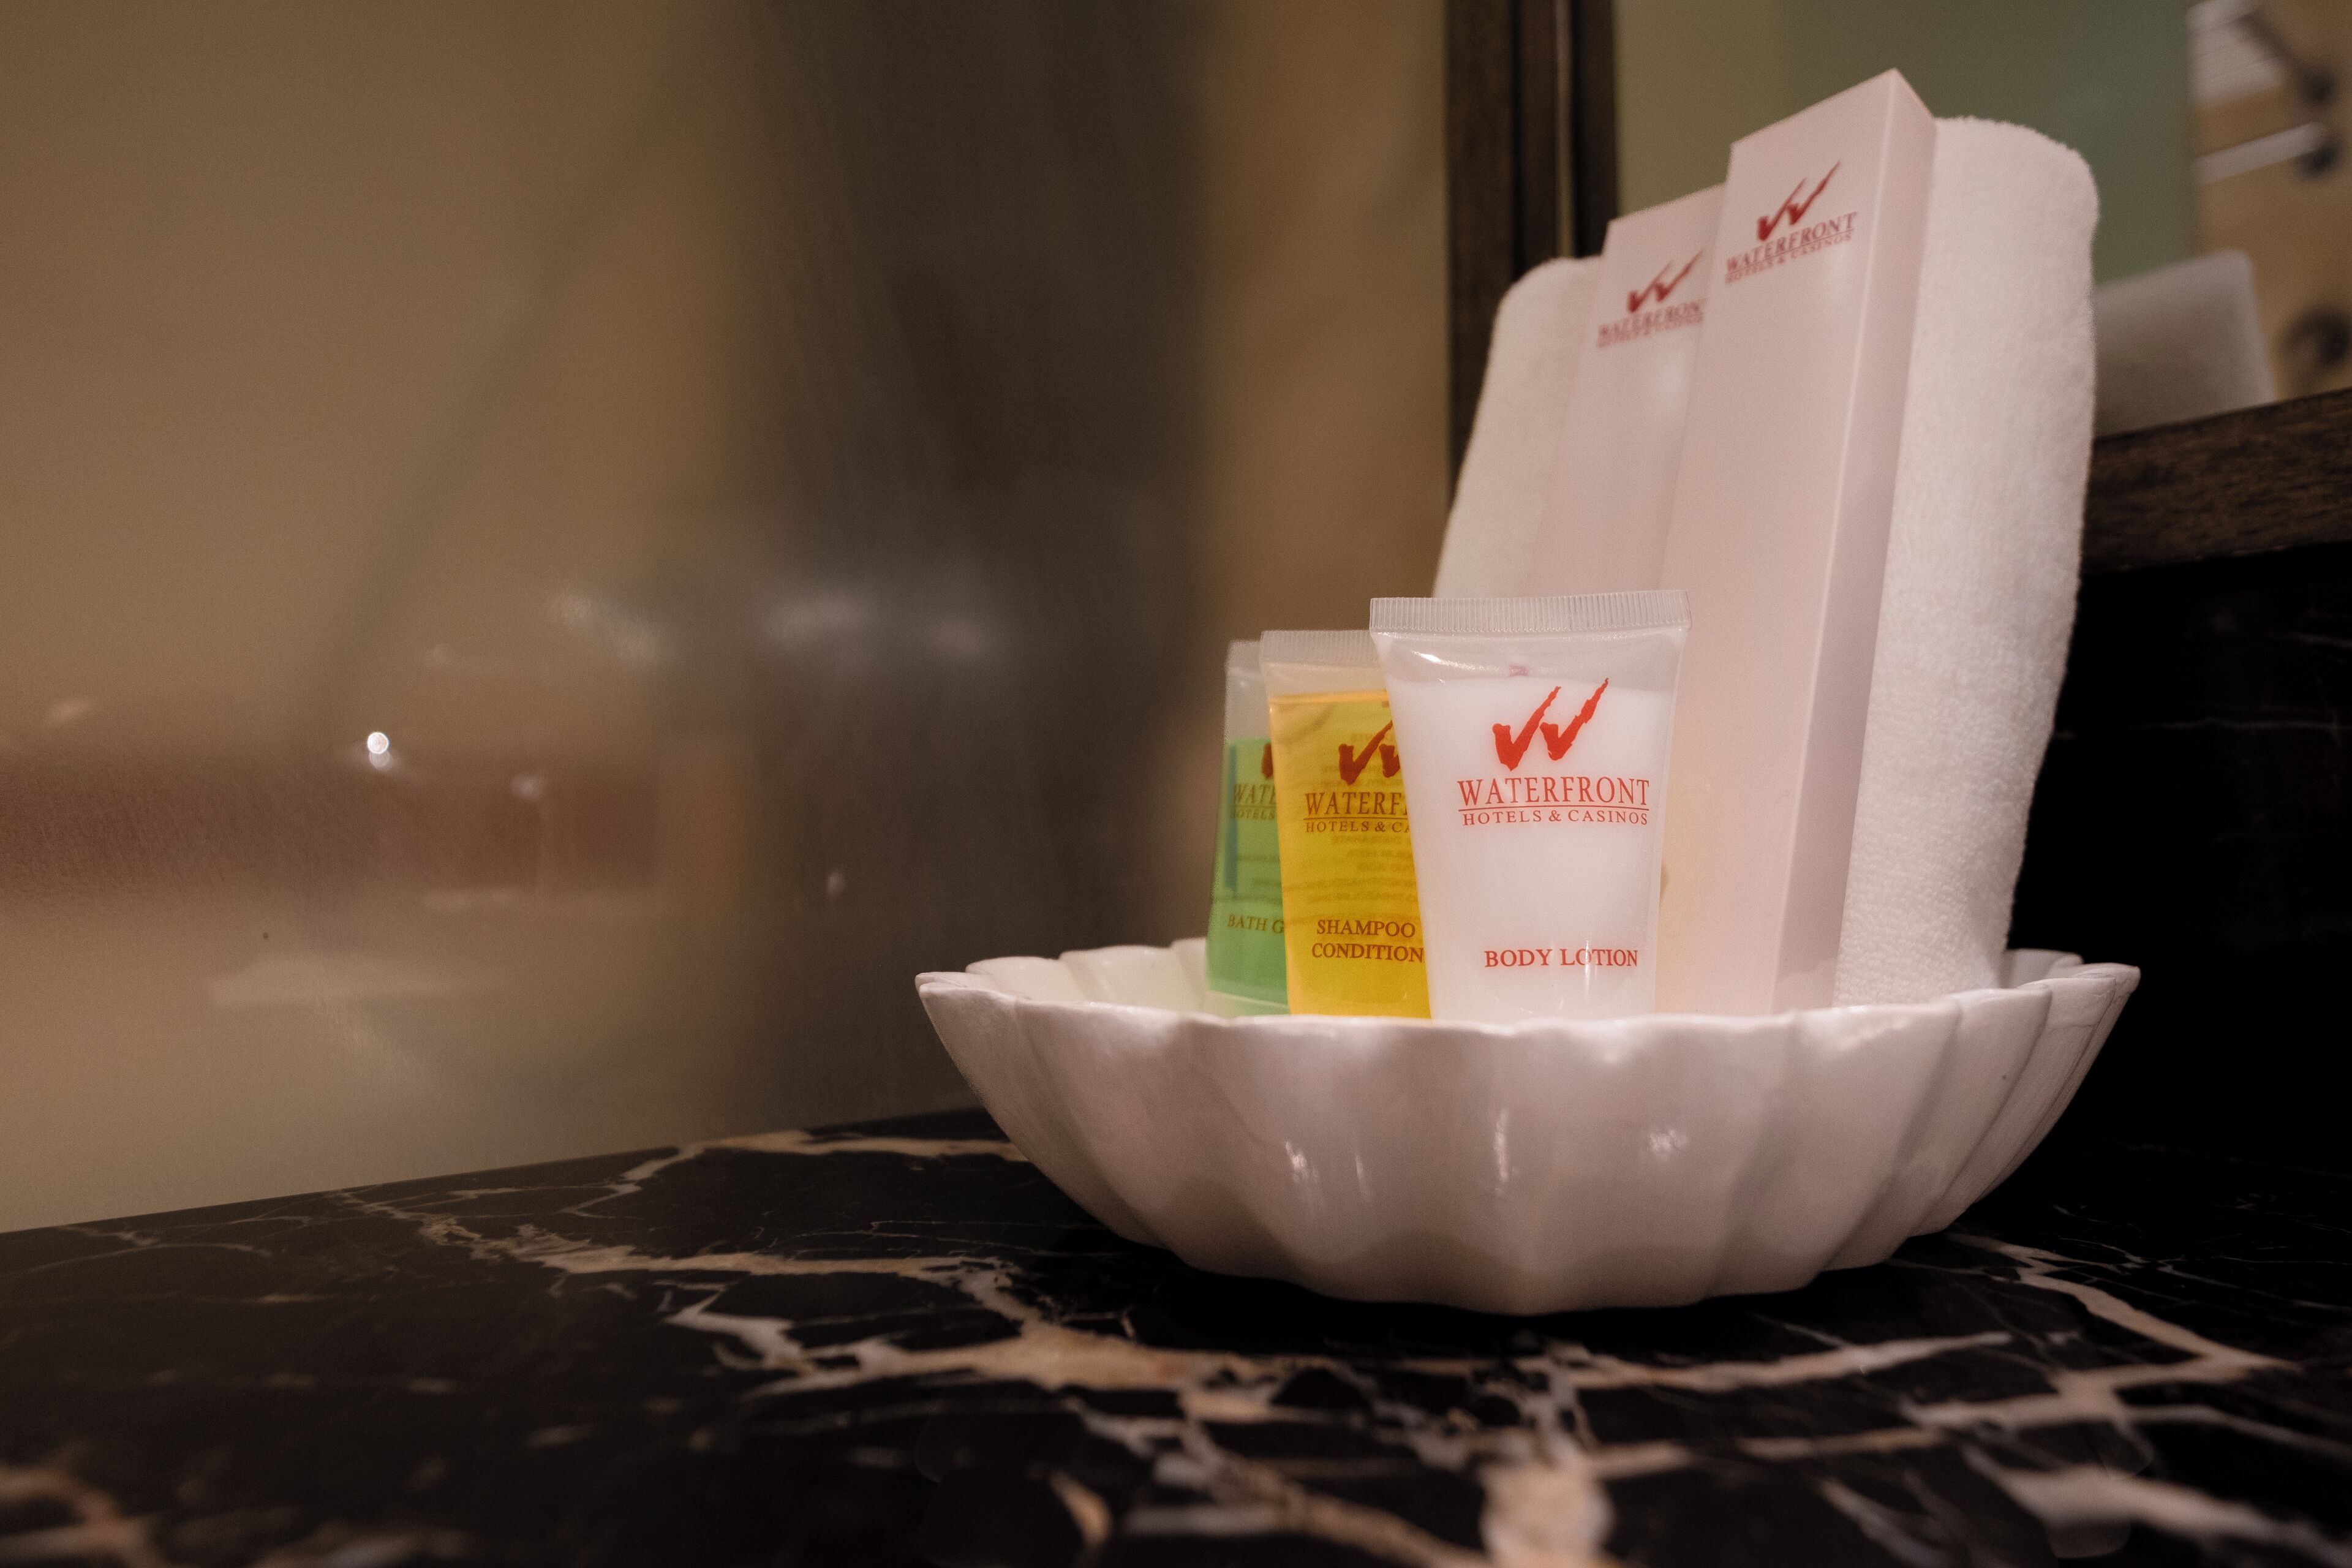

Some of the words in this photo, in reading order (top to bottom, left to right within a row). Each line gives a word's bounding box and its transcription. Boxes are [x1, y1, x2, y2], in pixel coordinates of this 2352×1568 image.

[1727, 211, 1857, 275] WATERFRONT
[1457, 776, 1649, 806] WATERFRONT
[1304, 791, 1408, 815] WATERF
[1305, 820, 1370, 833] HOTELS
[1374, 821, 1386, 832] &
[1462, 810, 1542, 826] HOTELS
[1549, 810, 1562, 822] &
[1567, 809, 1648, 826] CASINOS
[1227, 914, 1267, 931] BATH
[1317, 919, 1415, 938] SHAMPOO
[1311, 943, 1425, 963] CONDITION
[1483, 948, 1553, 968] BODY
[1559, 948, 1638, 967] LOTION
